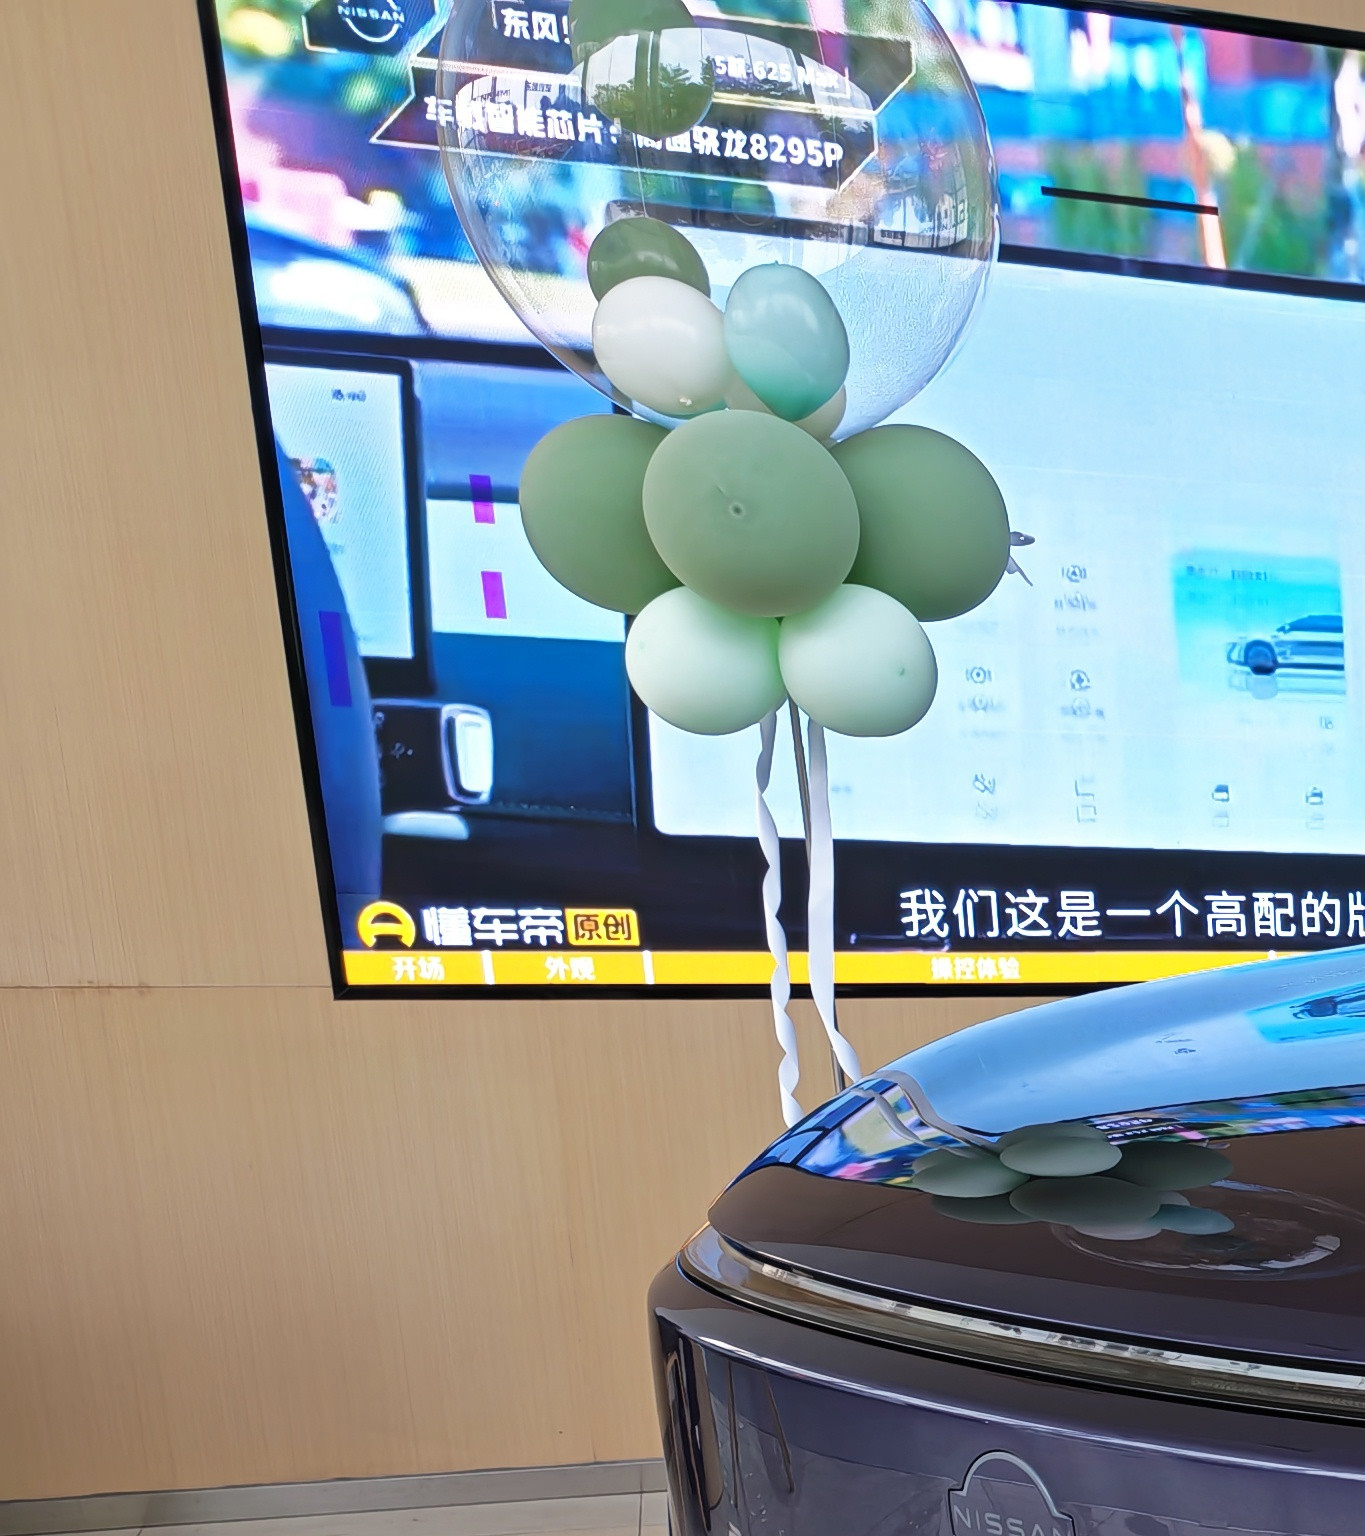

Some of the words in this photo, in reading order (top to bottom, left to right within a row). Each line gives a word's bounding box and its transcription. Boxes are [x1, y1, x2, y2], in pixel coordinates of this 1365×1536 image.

[337, 5, 405, 24] NISSAN
[420, 906, 564, 947] 懂车帝
[573, 912, 633, 942] 原创
[391, 956, 446, 981] 开场
[544, 956, 596, 981] 外观
[930, 956, 1020, 980] 操控体验
